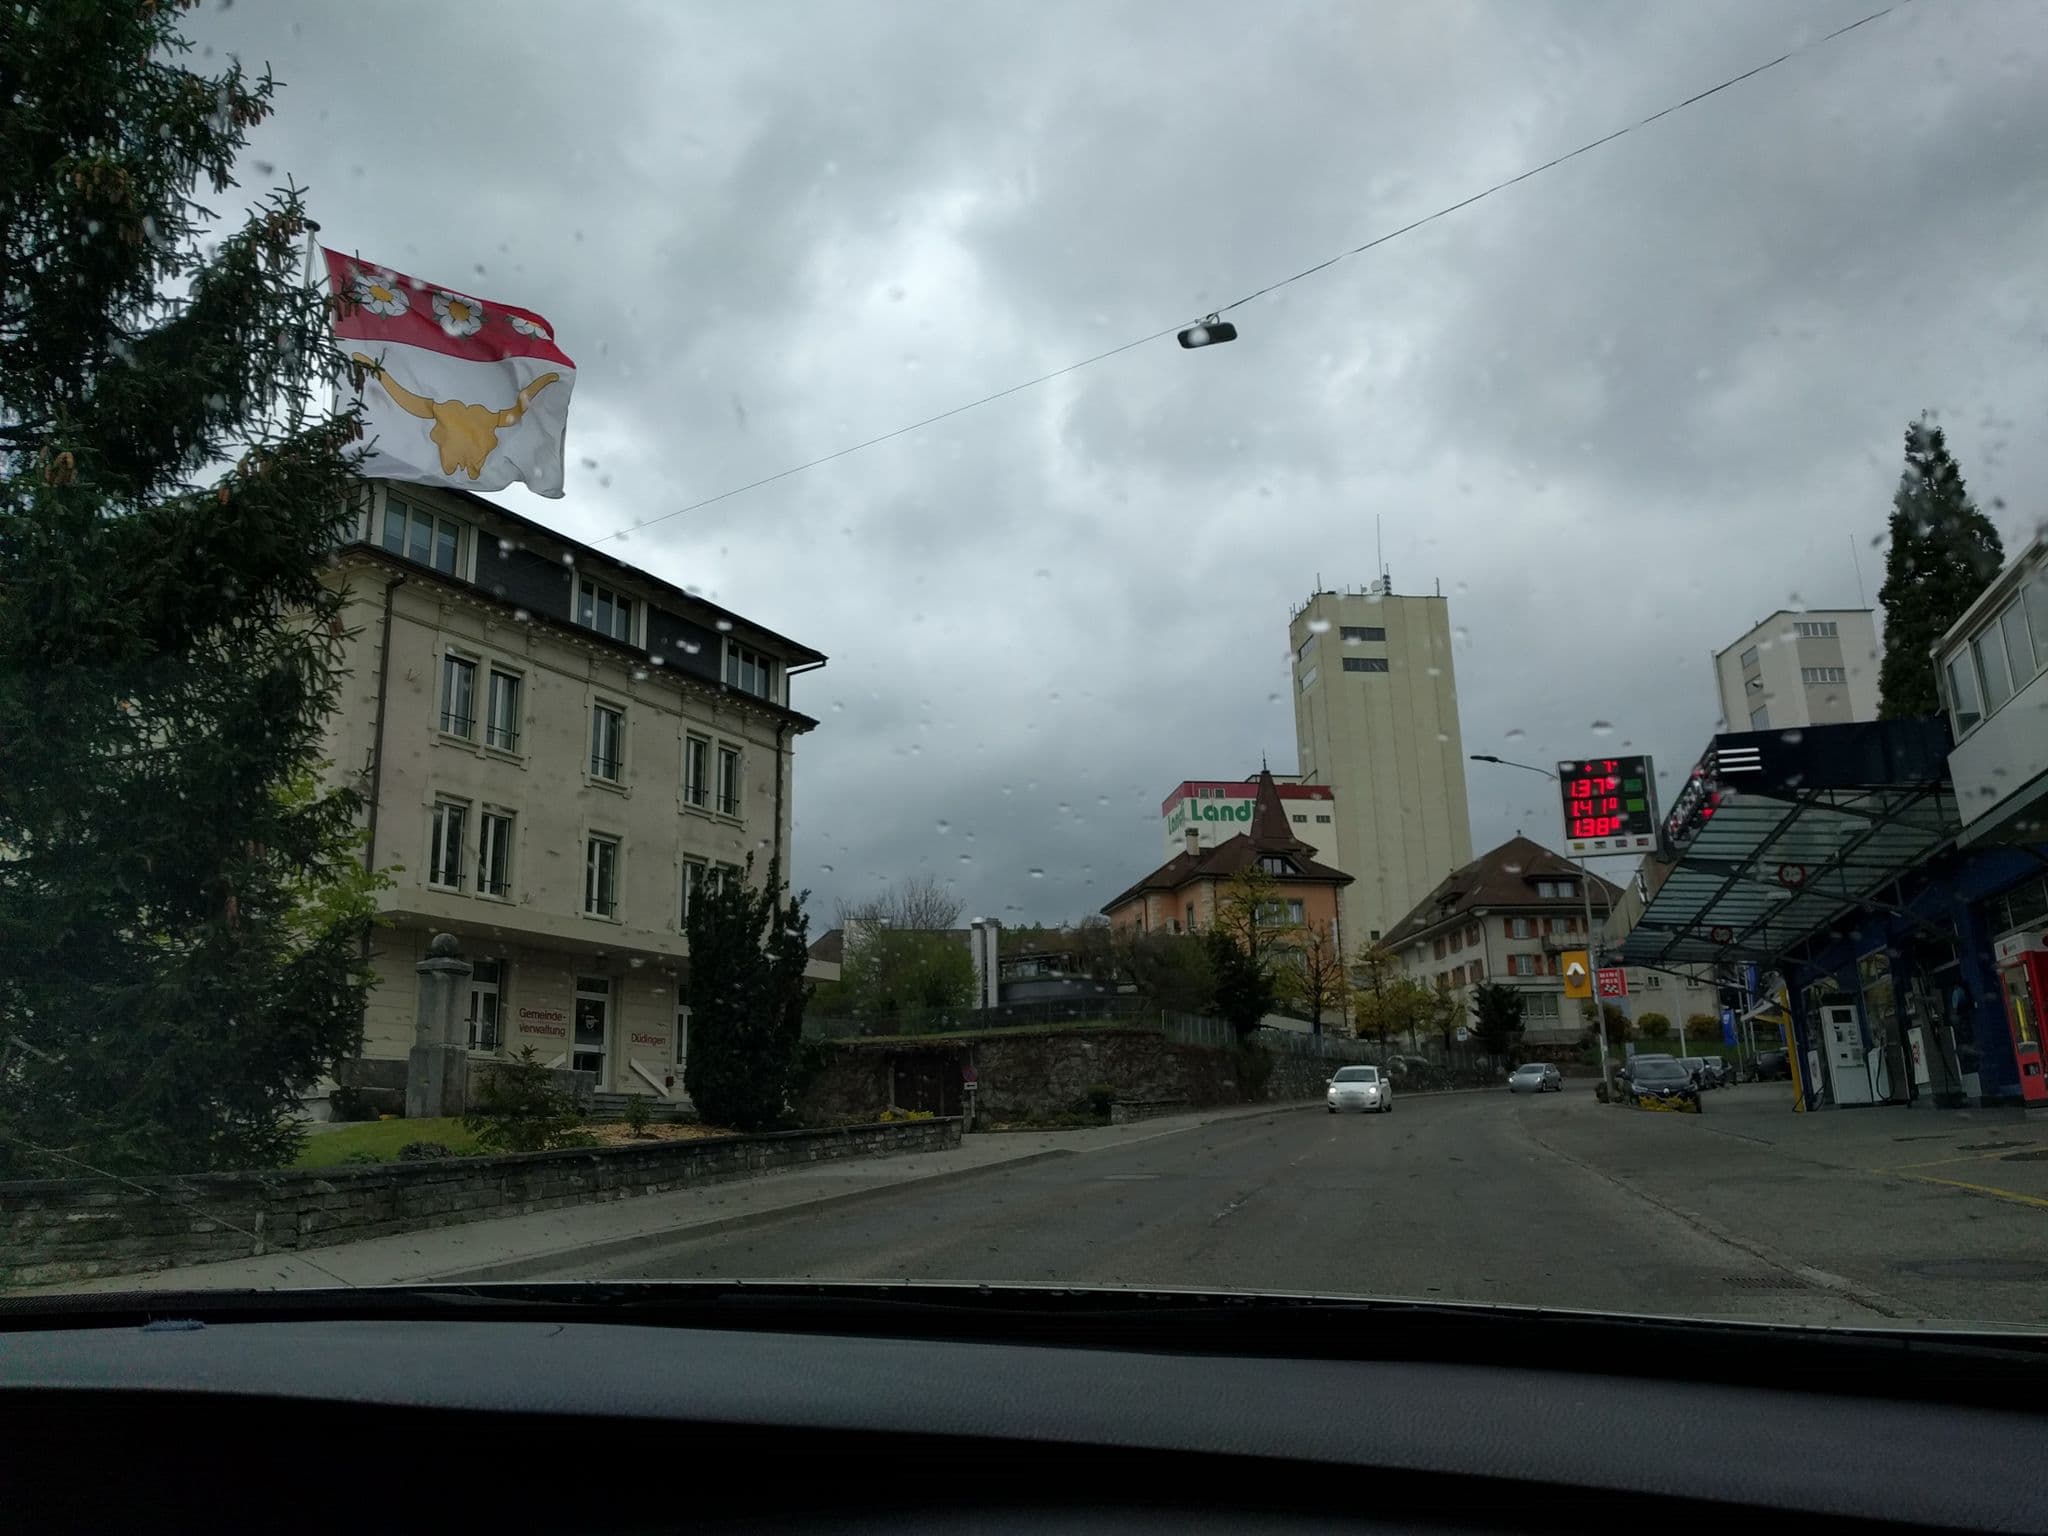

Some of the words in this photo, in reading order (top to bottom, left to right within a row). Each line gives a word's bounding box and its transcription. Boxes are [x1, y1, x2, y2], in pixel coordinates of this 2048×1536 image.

[1190, 799, 1257, 821] Land
[519, 1008, 567, 1021] Gemeinde-
[631, 1033, 666, 1046] Düdingen
